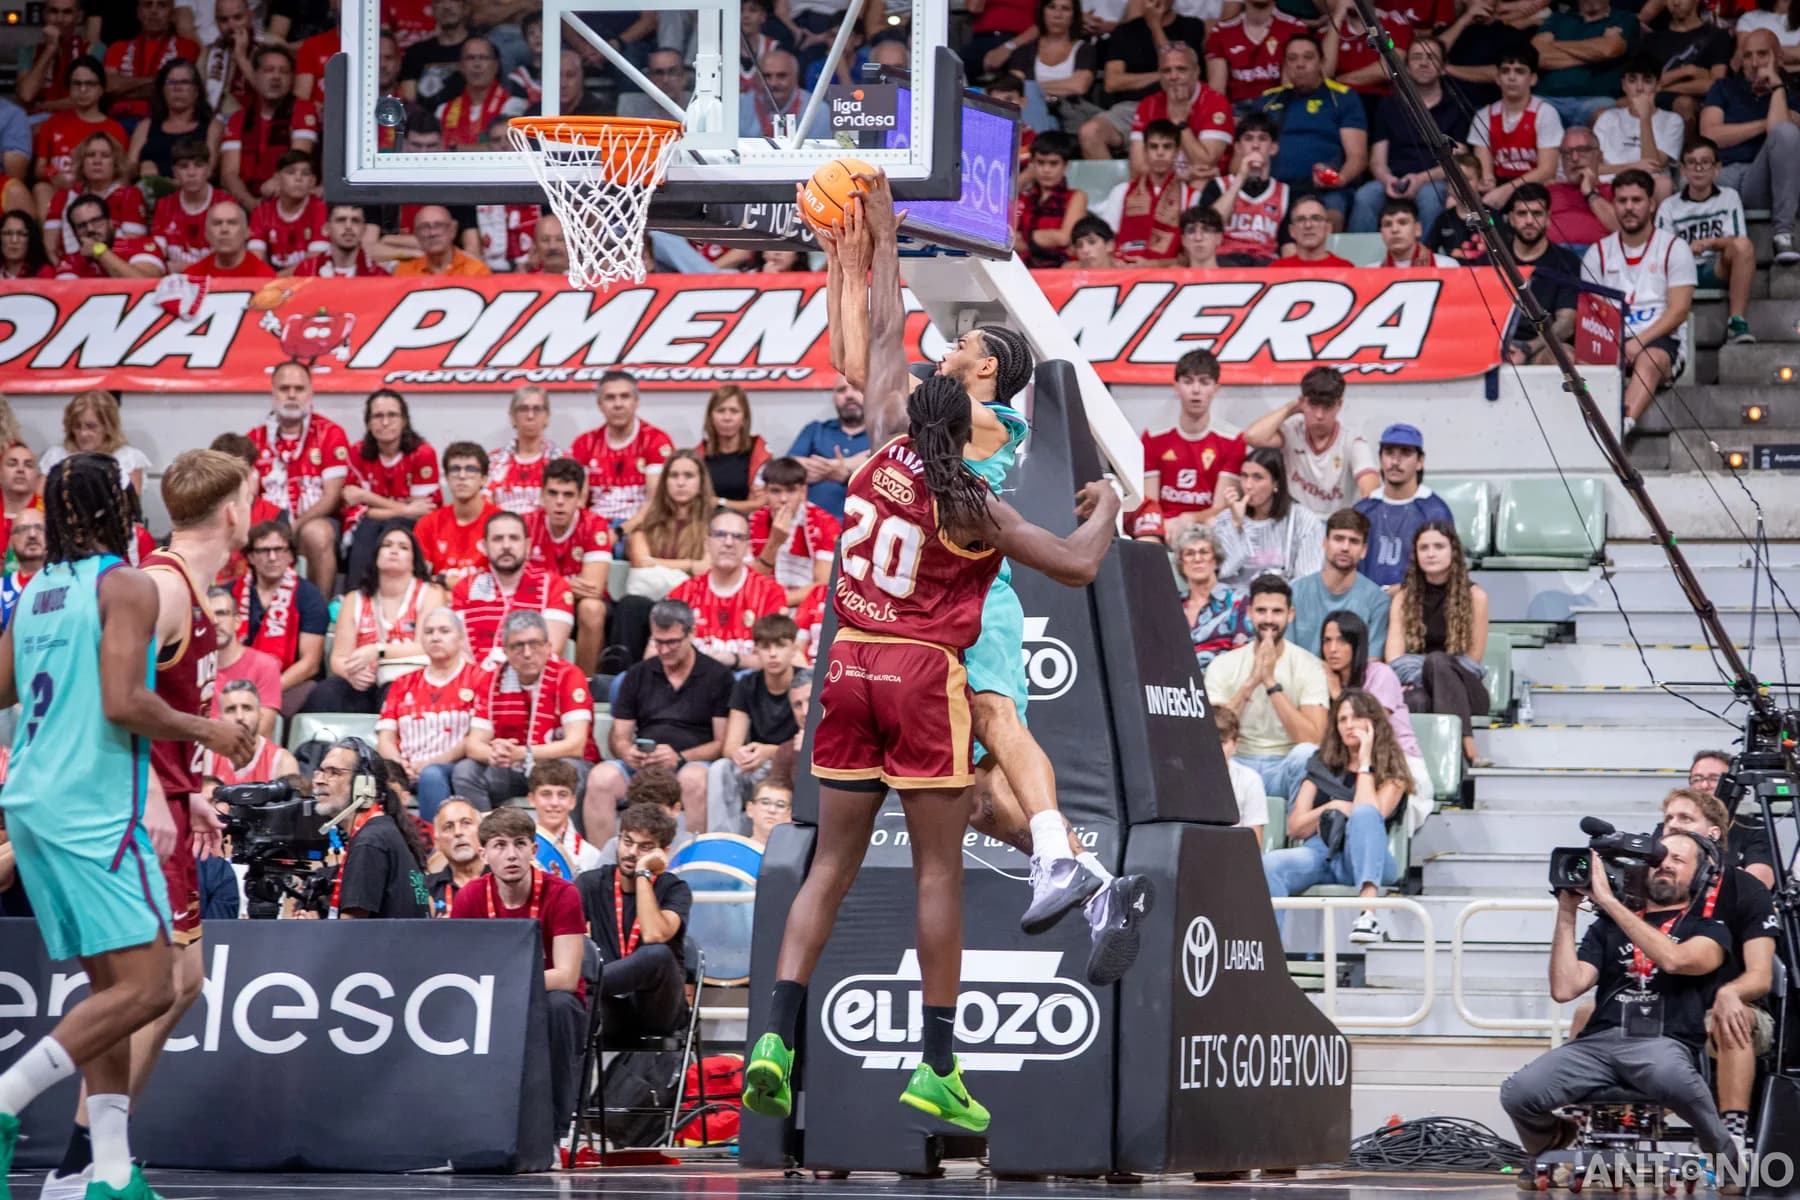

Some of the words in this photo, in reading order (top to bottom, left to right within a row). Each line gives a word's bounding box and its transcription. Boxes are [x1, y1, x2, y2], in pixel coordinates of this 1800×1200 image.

[833, 98, 862, 114] liga
[833, 113, 895, 127] endesa
[841, 494, 926, 600] 20
[1145, 676, 1205, 719] INVERSUS
[1224, 940, 1264, 971] LABASA
[1180, 1035, 1228, 1089] LET'S
[1233, 1033, 1265, 1088] GO
[1270, 1033, 1349, 1087] BEYOND
